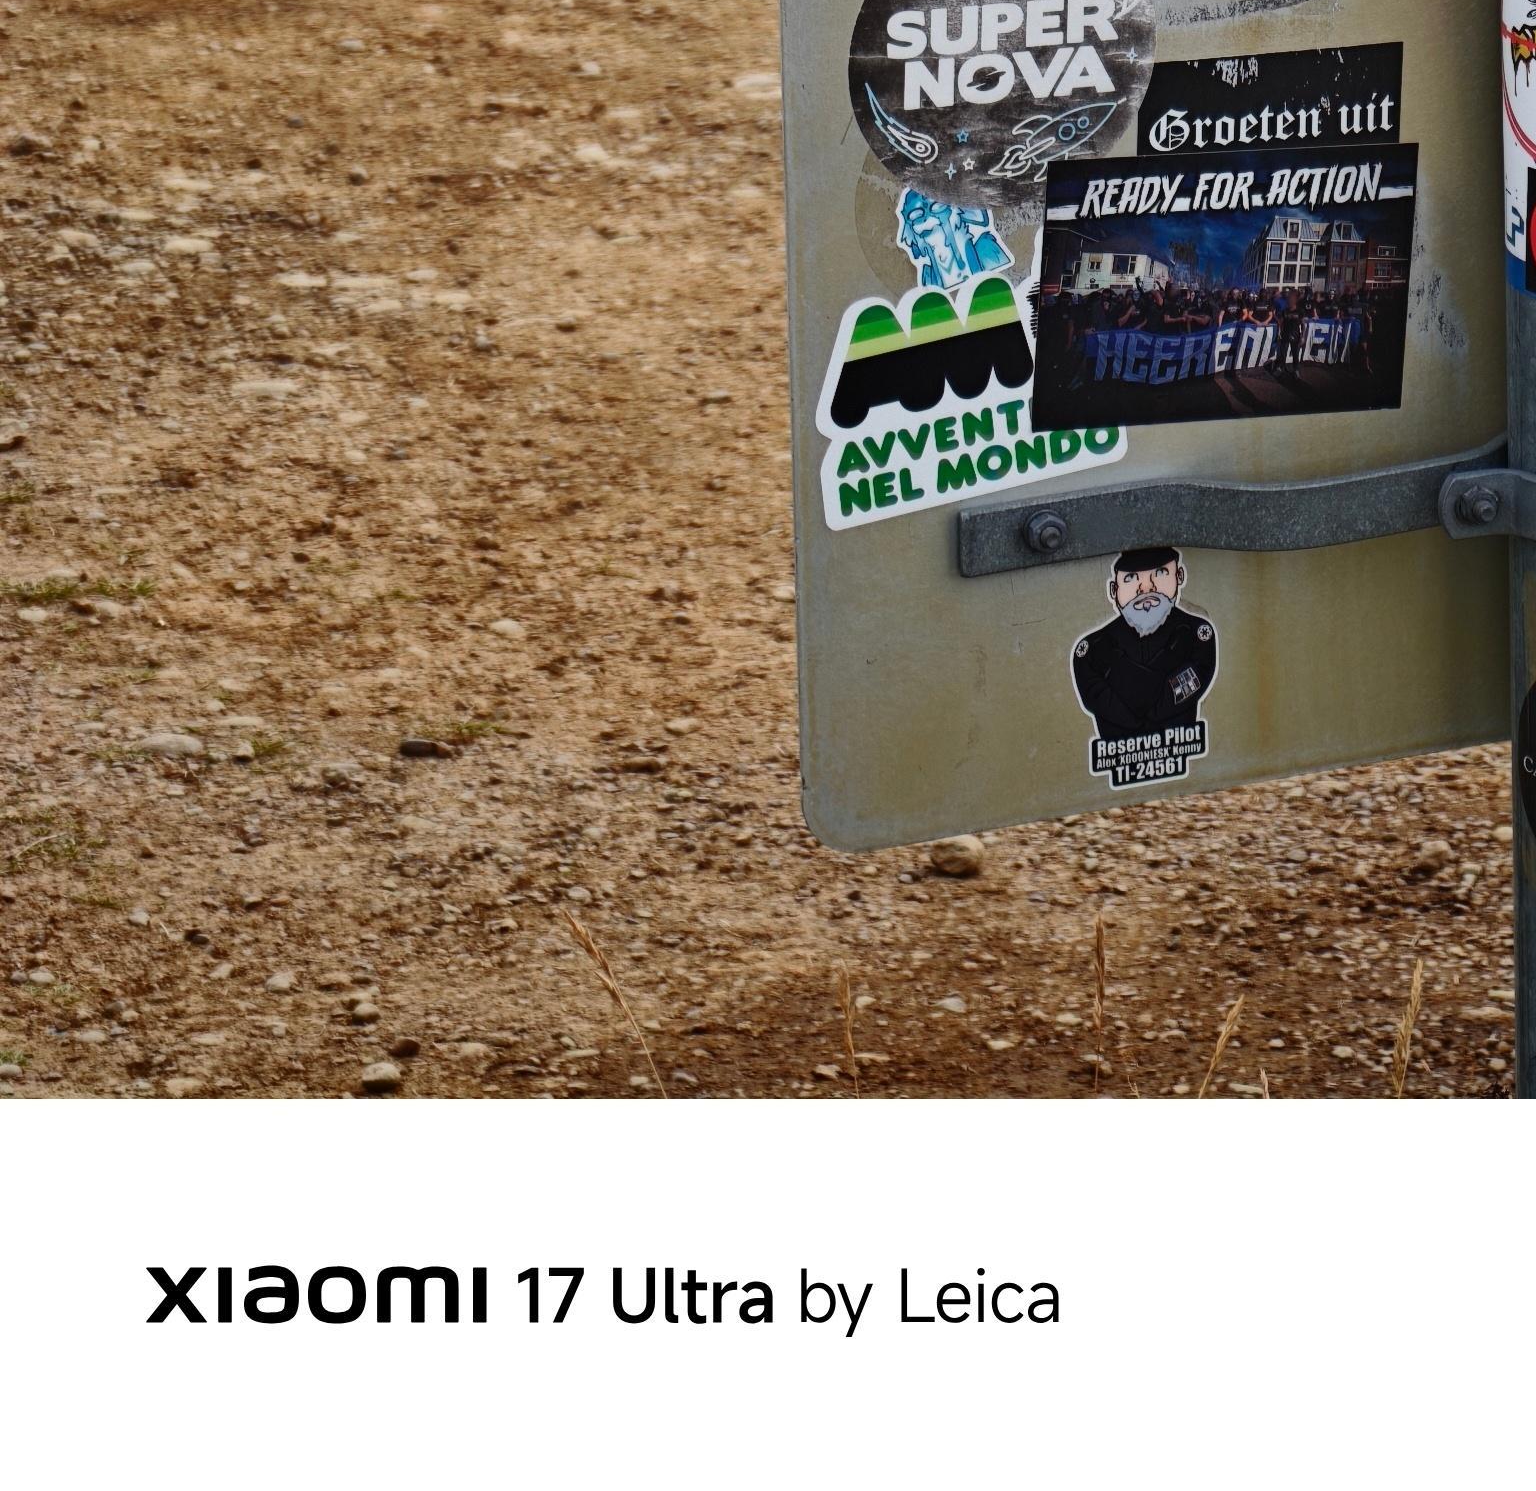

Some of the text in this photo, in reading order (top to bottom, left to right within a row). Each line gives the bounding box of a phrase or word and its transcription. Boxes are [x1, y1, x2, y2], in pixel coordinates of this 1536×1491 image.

[904, 45, 1116, 111] NOVA
[1148, 93, 1395, 152] Groeten uit
[1078, 162, 1384, 220] READY FOR ACTION
[838, 425, 1121, 517] NEL MONDO
[1097, 723, 1202, 758] Reserve Pilot
